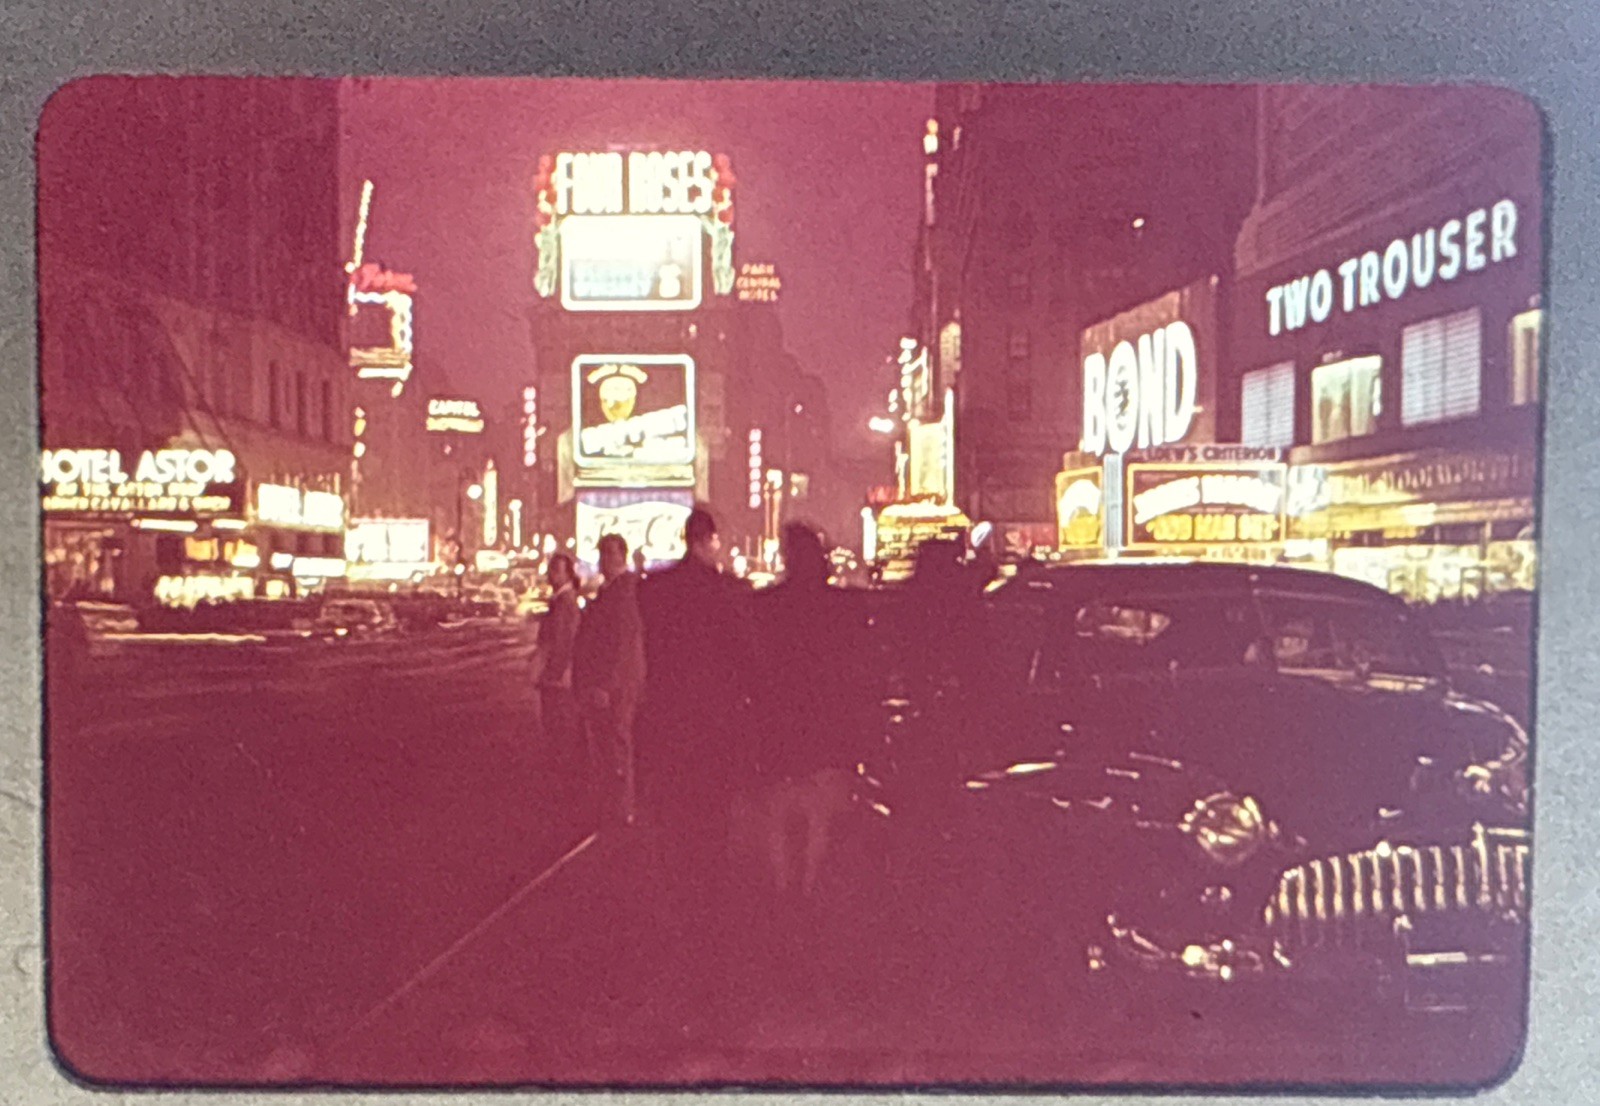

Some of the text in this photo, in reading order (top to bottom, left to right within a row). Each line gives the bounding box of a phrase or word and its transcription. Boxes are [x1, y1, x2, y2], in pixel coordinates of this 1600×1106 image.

[1266, 199, 1519, 336] TWO TROUSER
[1083, 320, 1197, 455] BOND
[135, 449, 235, 483] ASTOR
[1201, 446, 1277, 461] CRITERION
